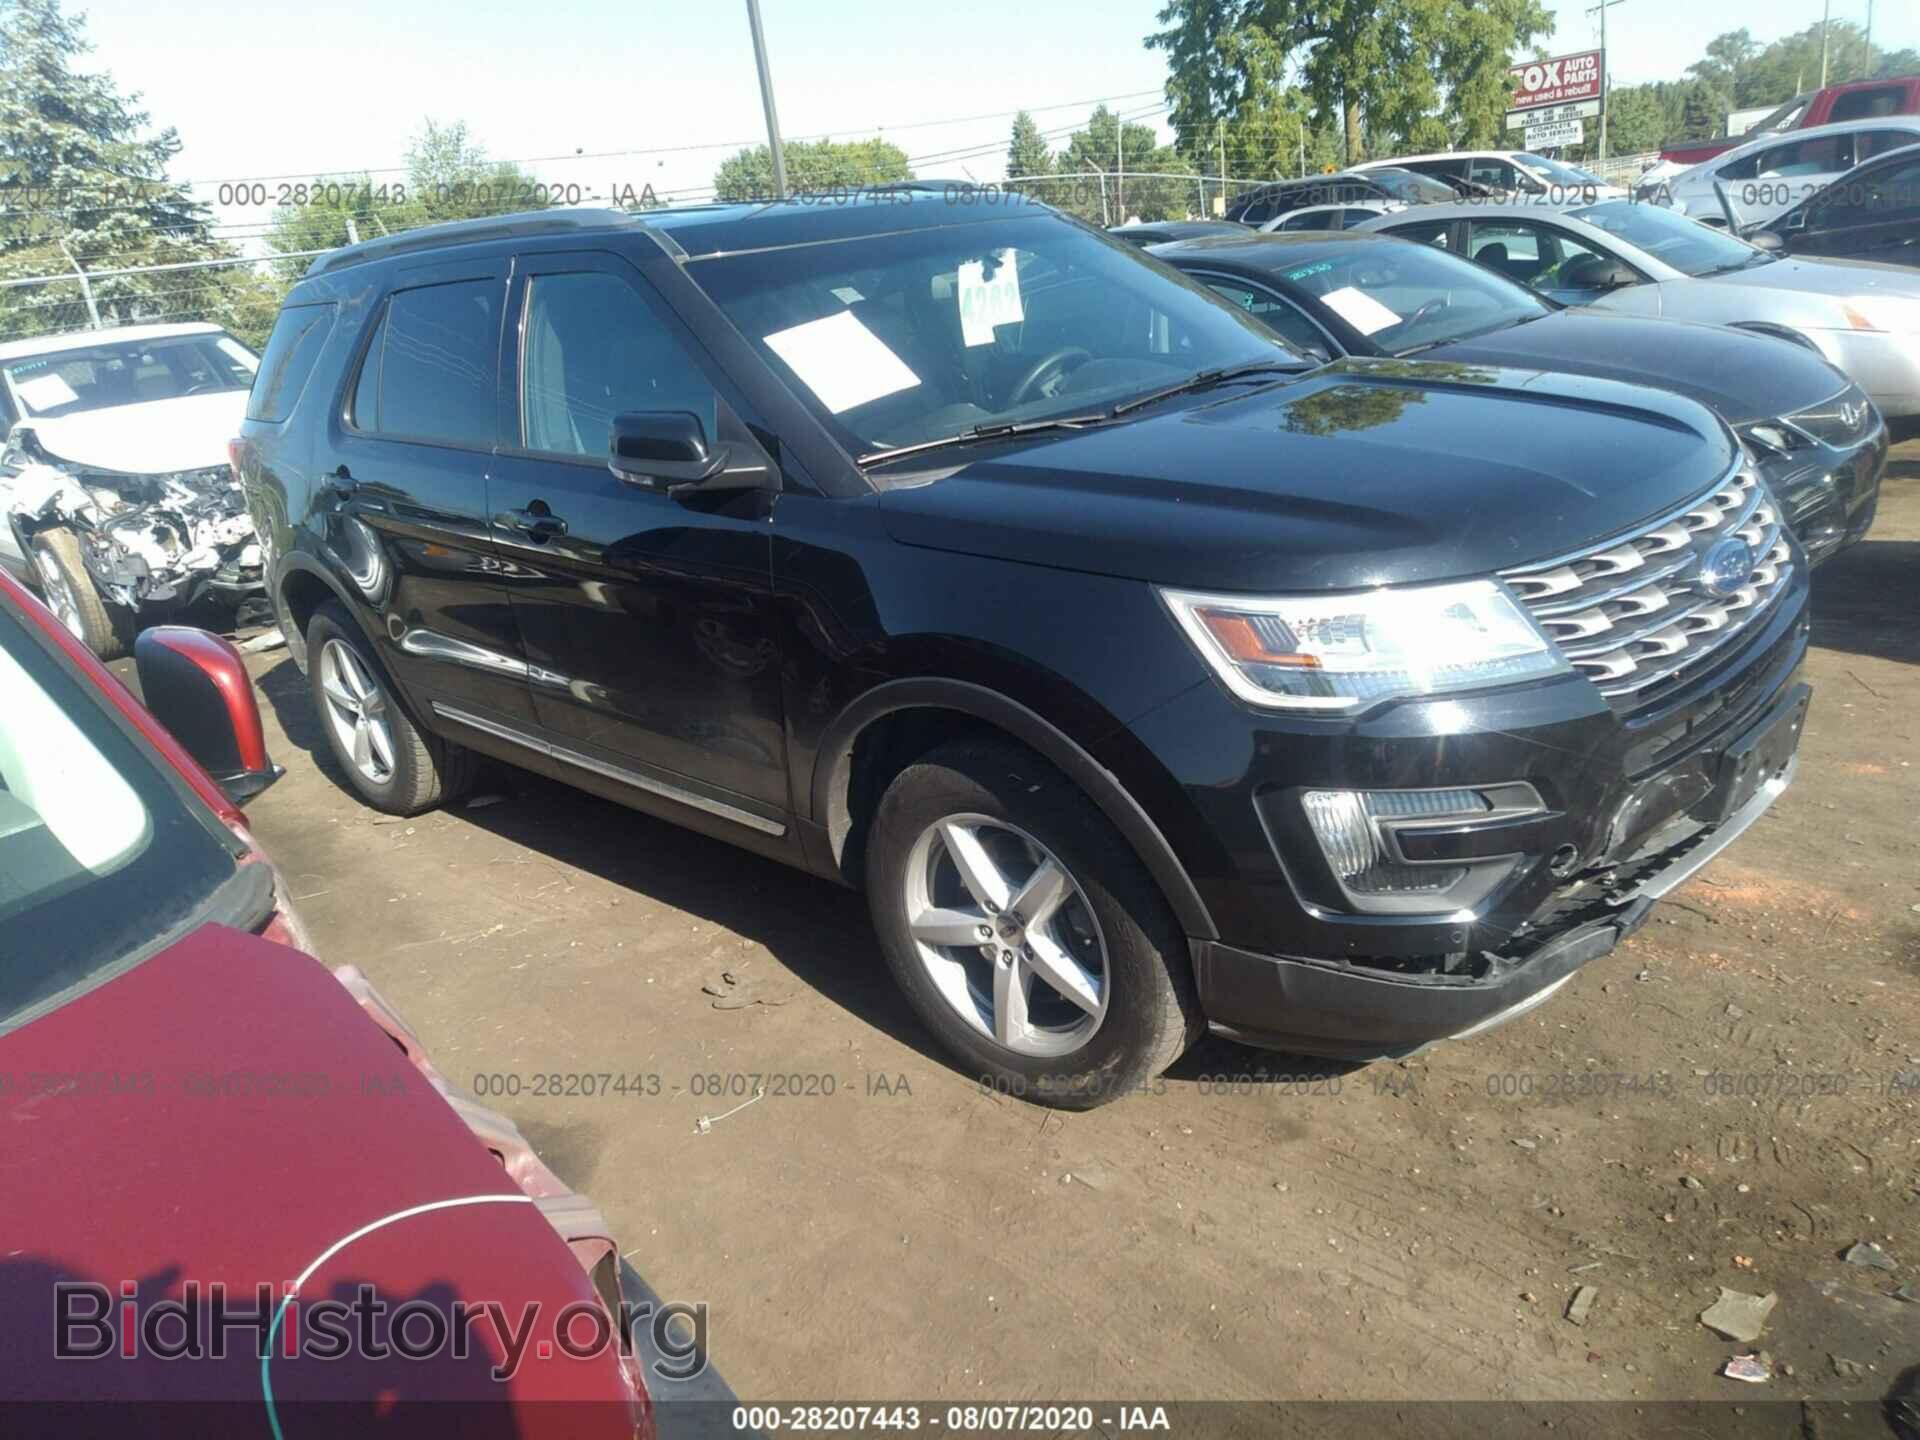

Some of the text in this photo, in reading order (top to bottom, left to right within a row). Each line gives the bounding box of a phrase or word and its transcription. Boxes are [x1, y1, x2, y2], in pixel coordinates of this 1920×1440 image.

[1565, 56, 1595, 70] AUTO
[1564, 68, 1598, 85] PARTS
[1564, 84, 1591, 98] rebuilt
[1527, 127, 1578, 141] AUTO SERVICE
[1533, 121, 1571, 133] COMPLETE
